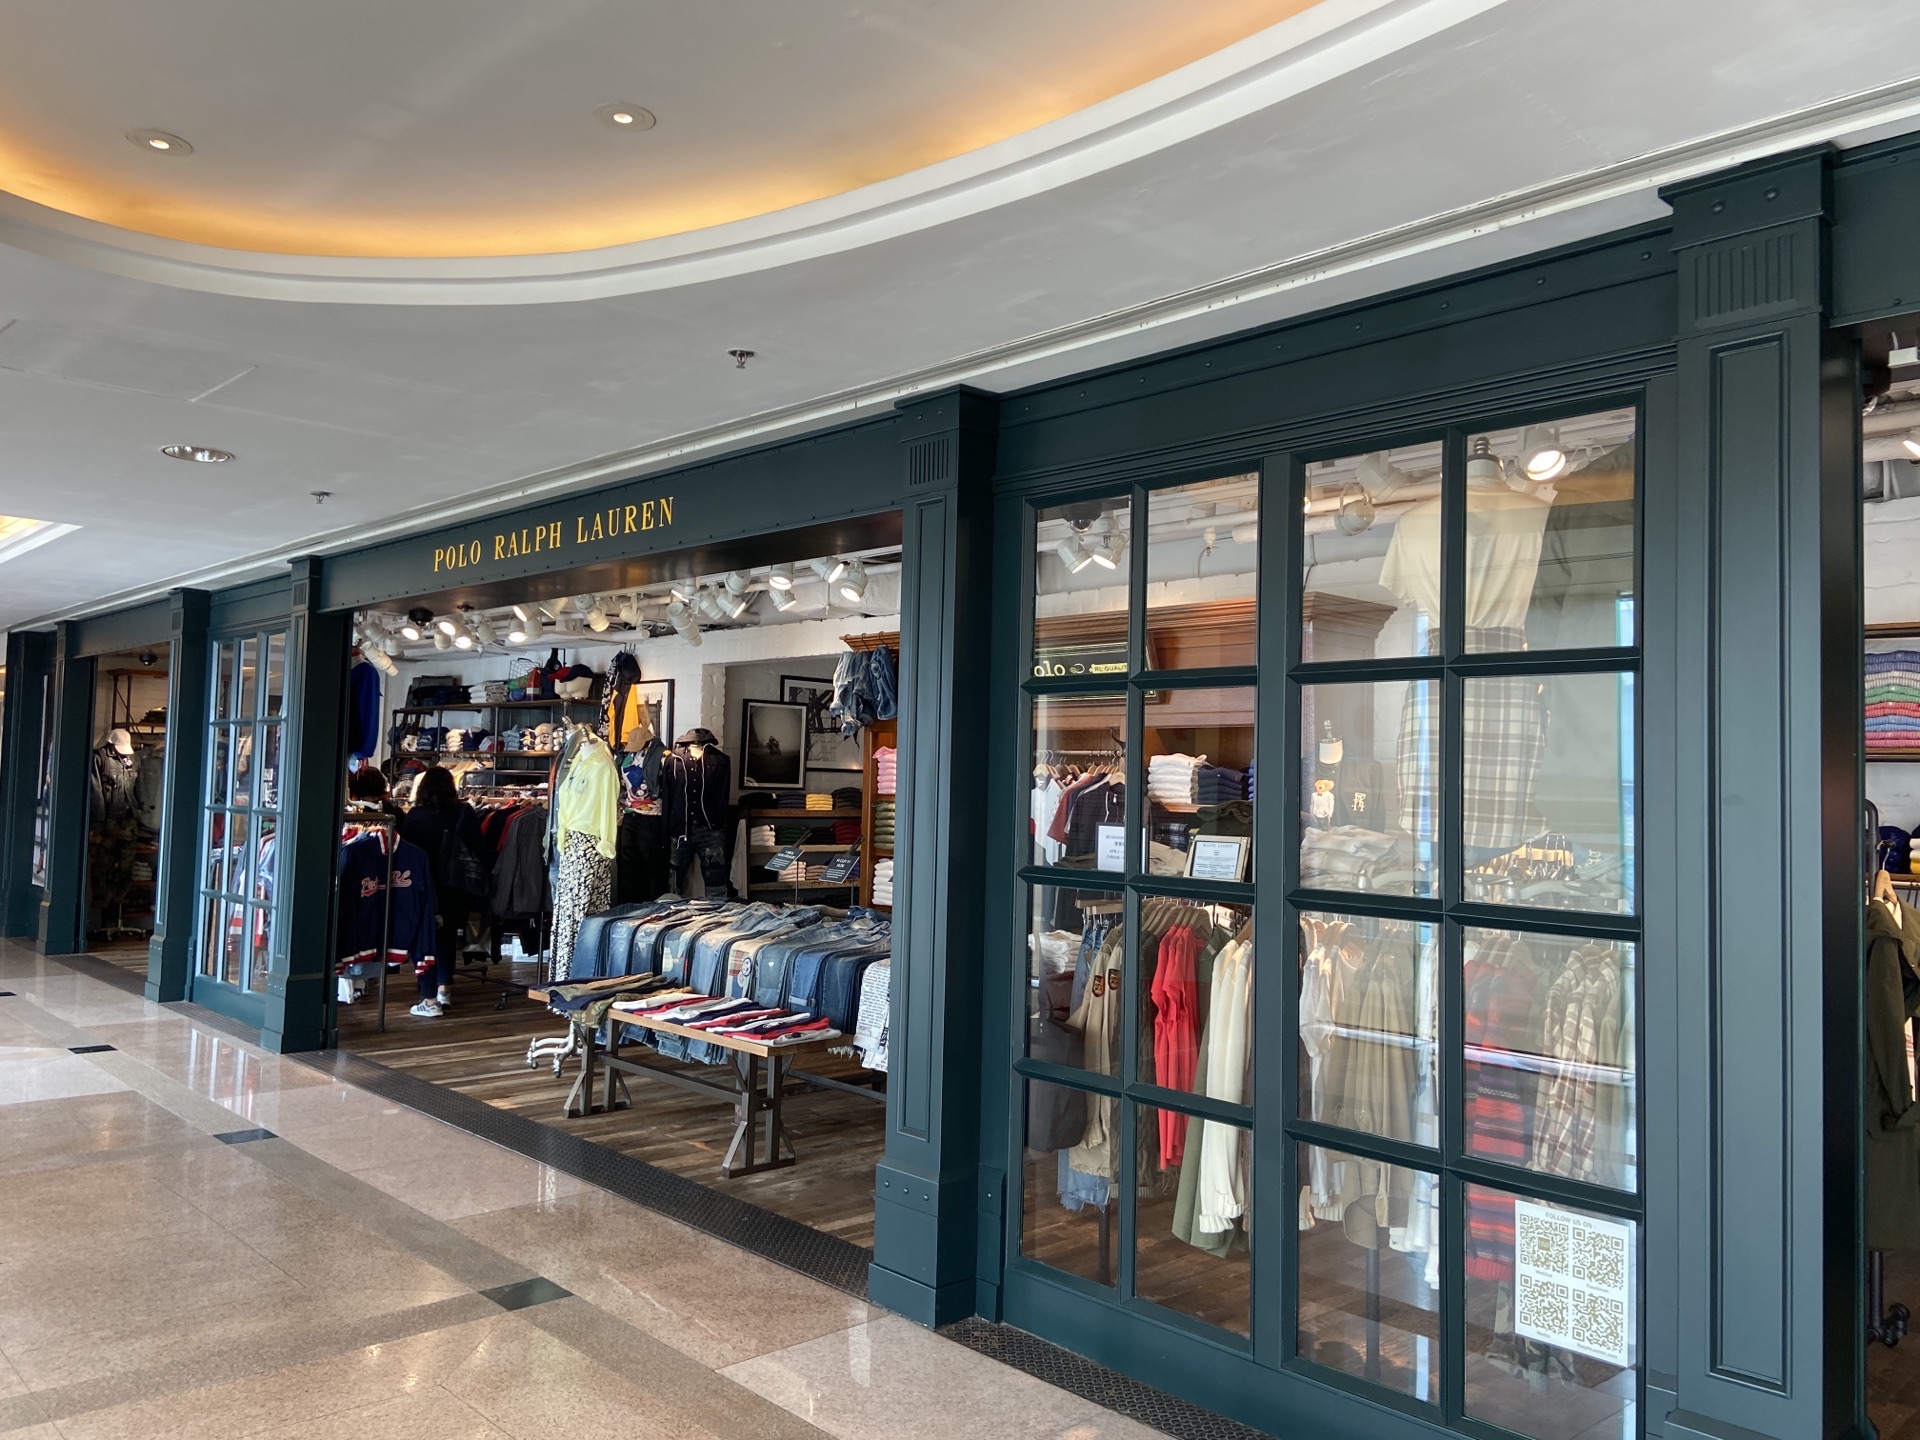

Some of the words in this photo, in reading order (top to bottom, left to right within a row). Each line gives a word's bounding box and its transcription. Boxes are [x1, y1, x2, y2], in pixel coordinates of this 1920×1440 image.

[433, 539, 482, 573] POLO
[494, 520, 562, 560] RALPH
[576, 495, 674, 544] LAUREN
[1545, 1211, 1572, 1224] FOLLOW
[1573, 1218, 1582, 1226] US
[1583, 1221, 1593, 1229] ON
